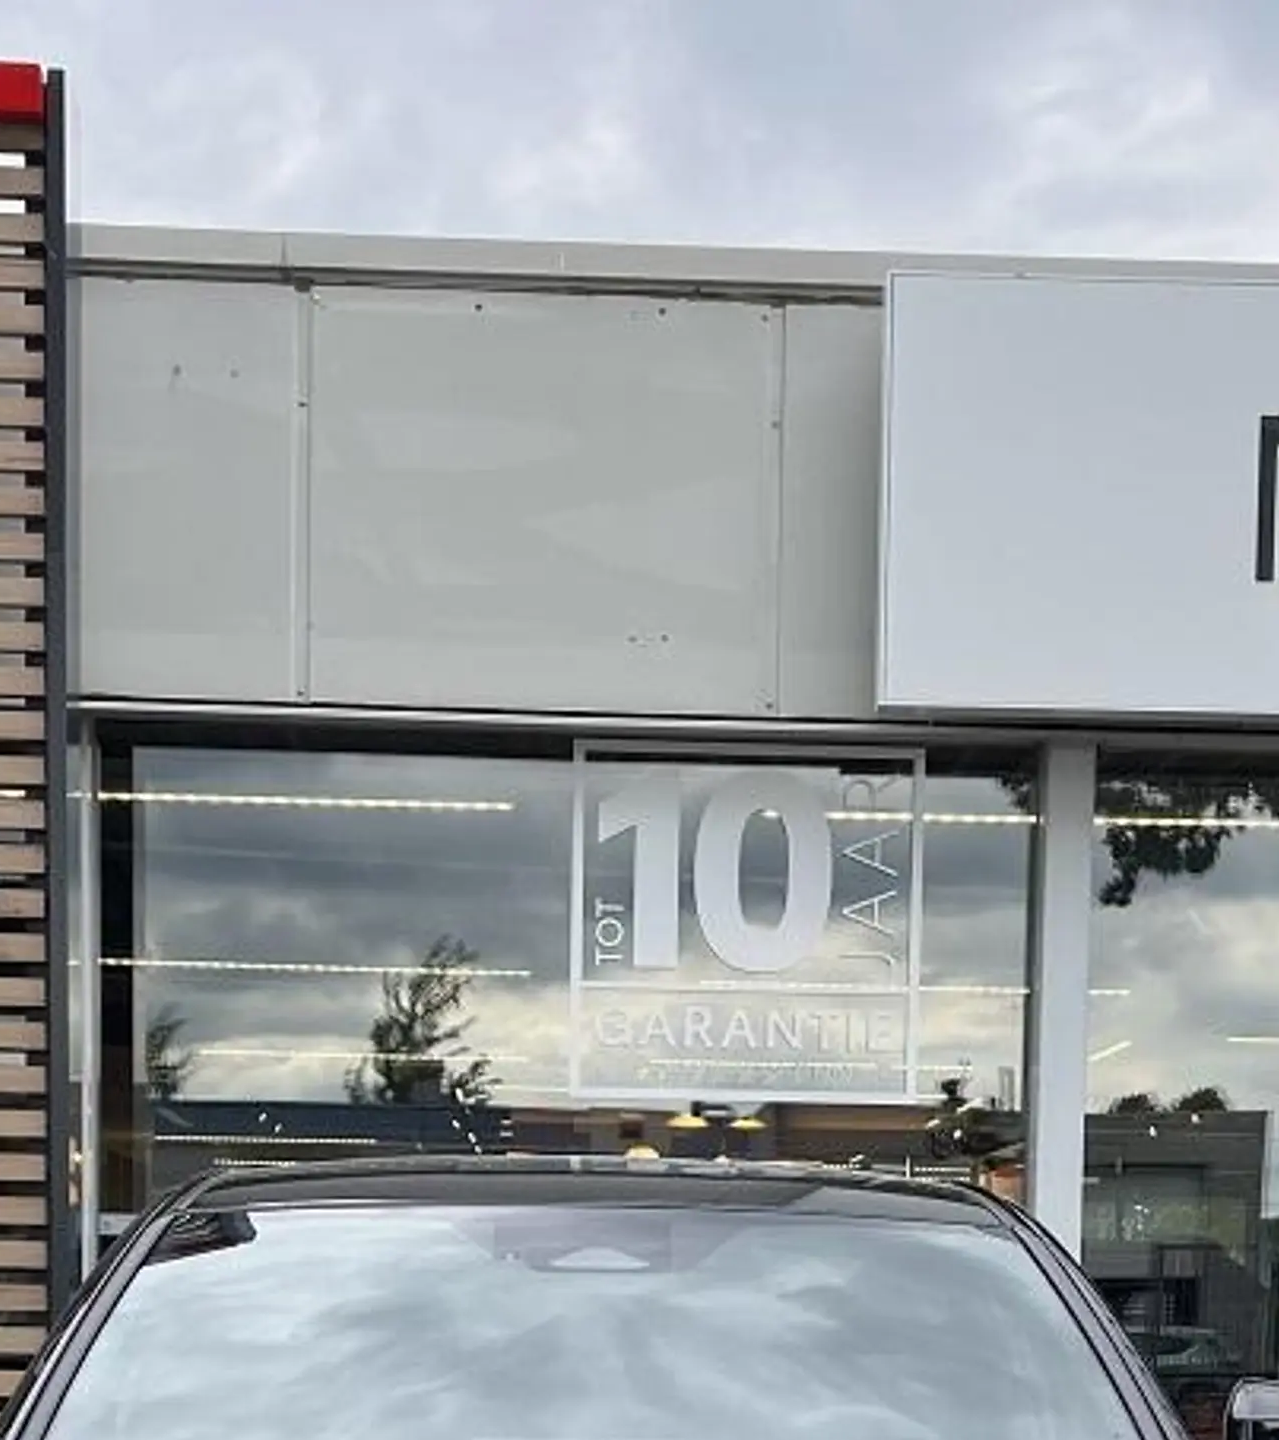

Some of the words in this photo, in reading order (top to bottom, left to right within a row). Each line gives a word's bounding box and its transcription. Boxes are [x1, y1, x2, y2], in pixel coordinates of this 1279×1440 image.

[594, 897, 626, 967] TOT
[597, 768, 834, 974] 10
[837, 775, 901, 968] JAAR
[594, 1006, 898, 1054] GARANTIE
